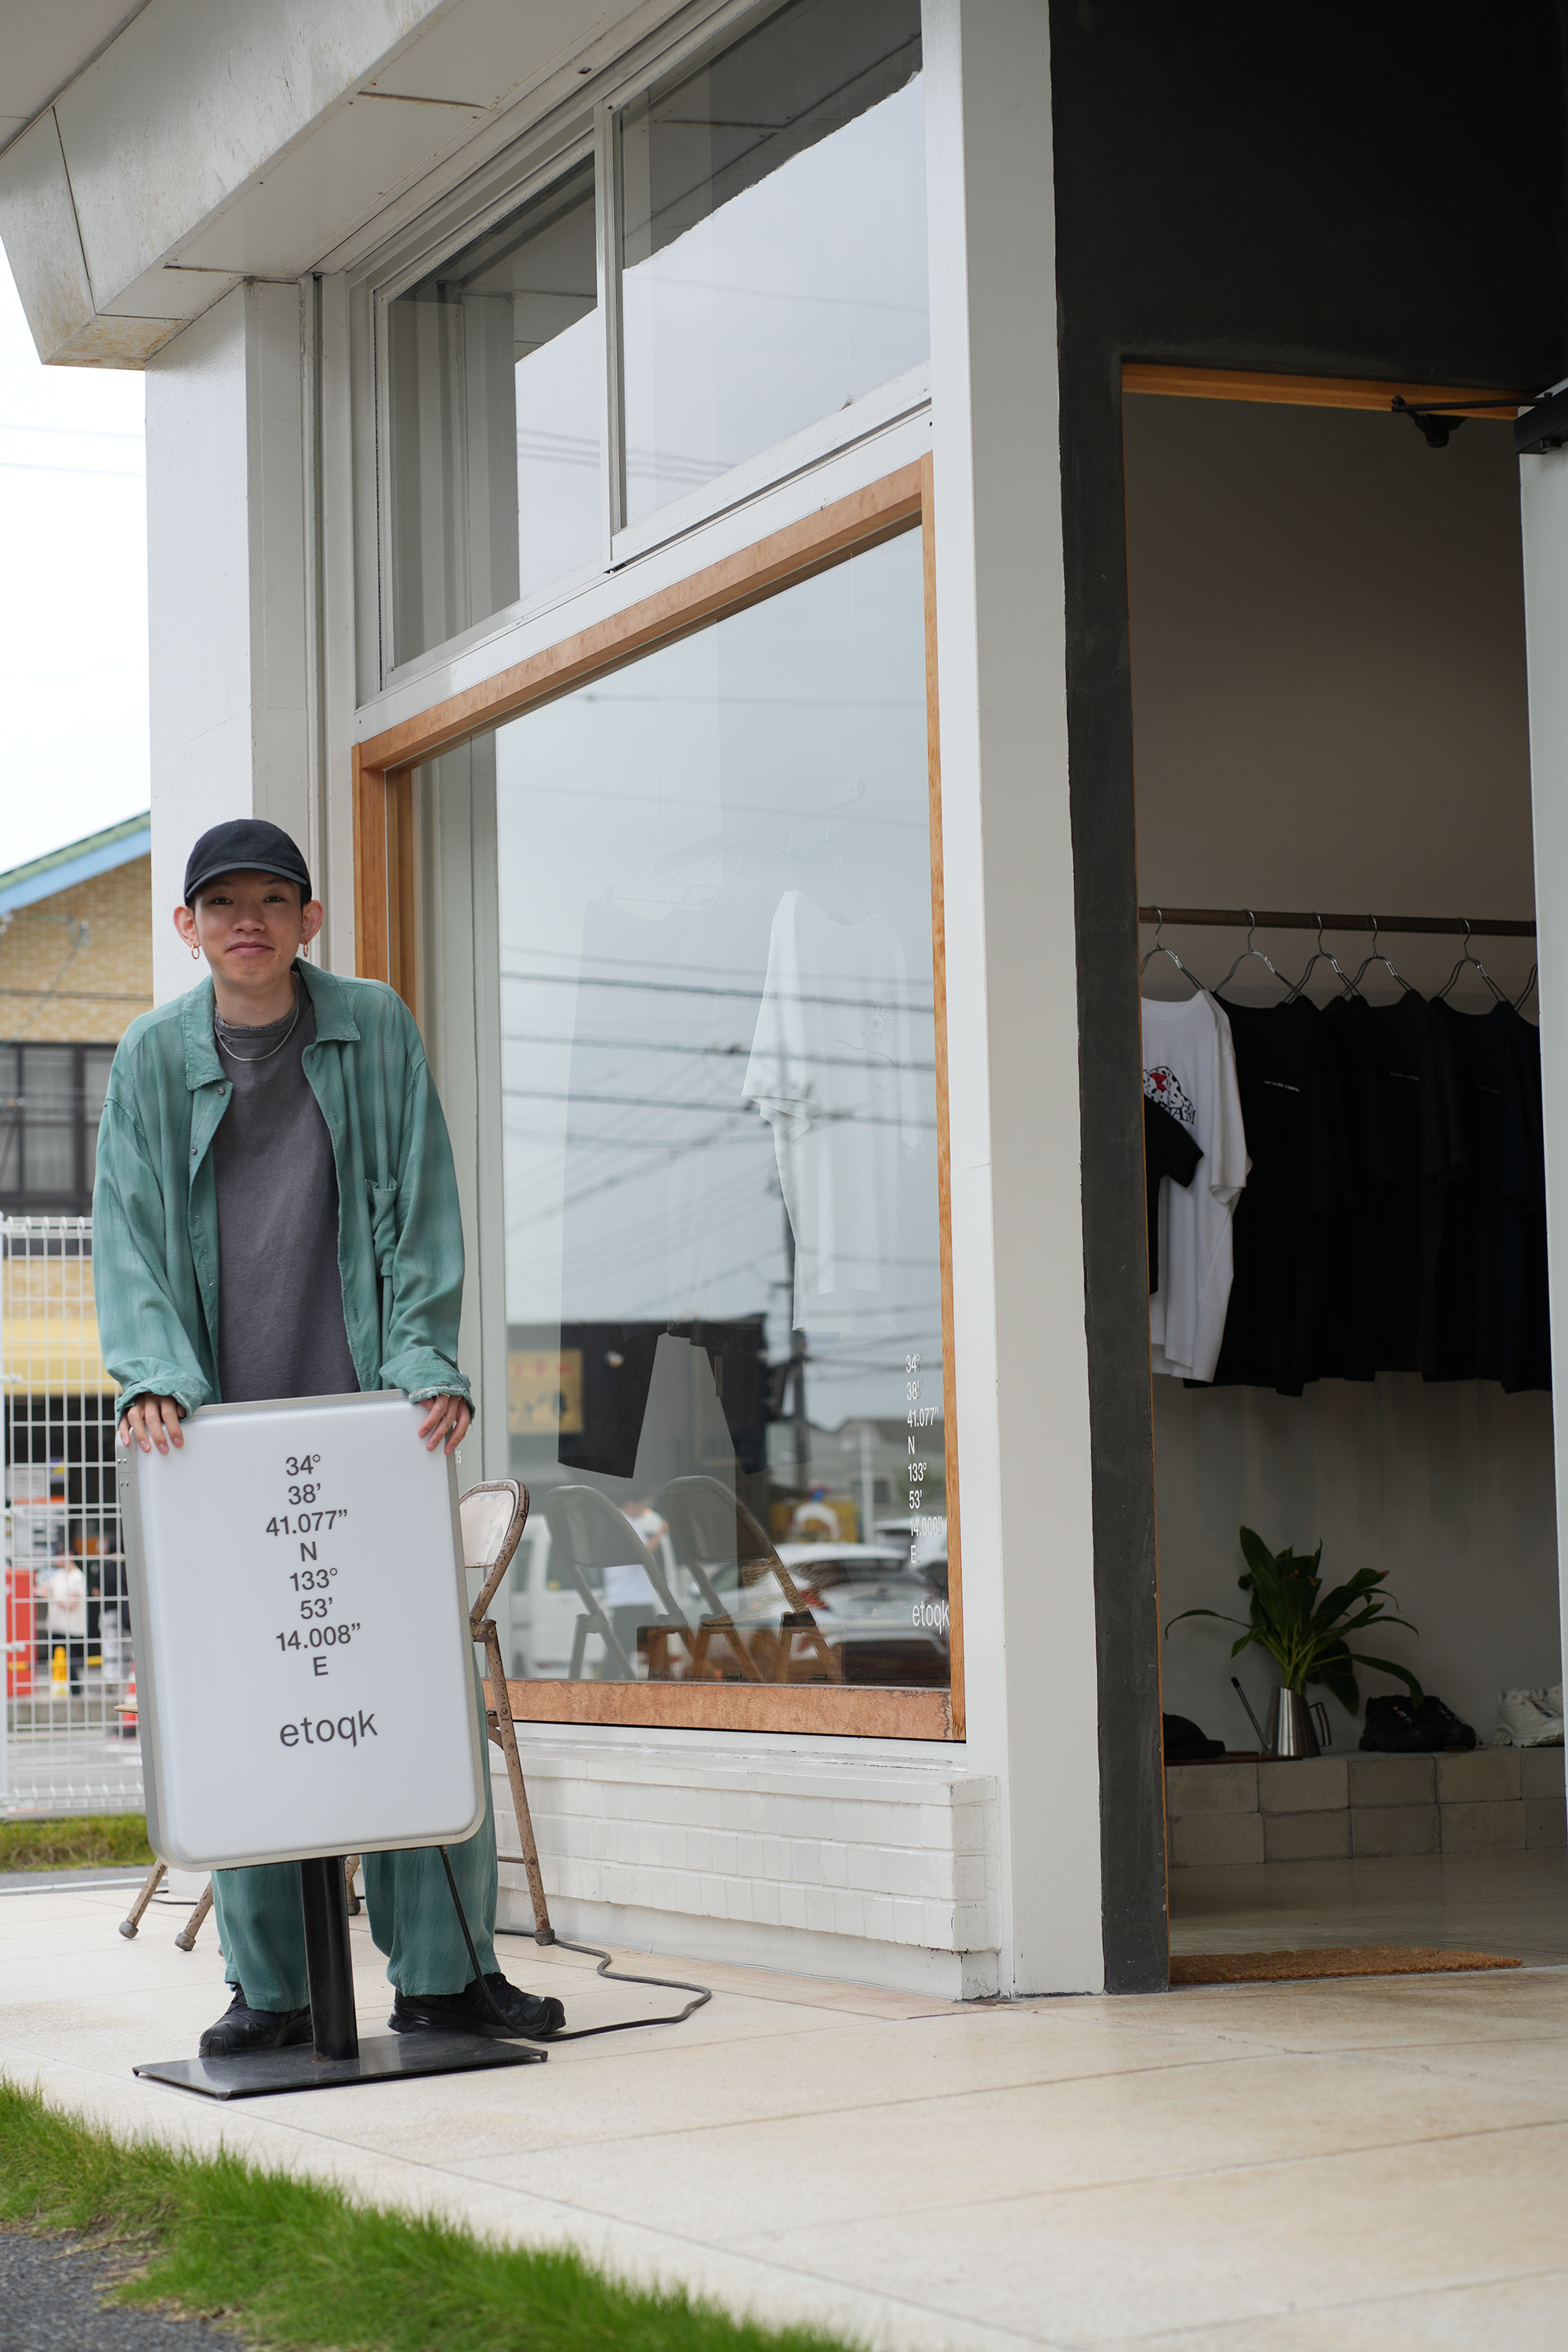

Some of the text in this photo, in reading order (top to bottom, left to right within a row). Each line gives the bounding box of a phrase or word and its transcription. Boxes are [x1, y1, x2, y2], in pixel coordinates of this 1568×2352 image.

[908, 1436, 915, 1455] N
[299, 1541, 318, 1563] N
[910, 1544, 917, 1564] E
[912, 1599, 950, 1635] etoqk
[313, 1656, 329, 1677] E
[279, 1710, 378, 1748] etoqk
